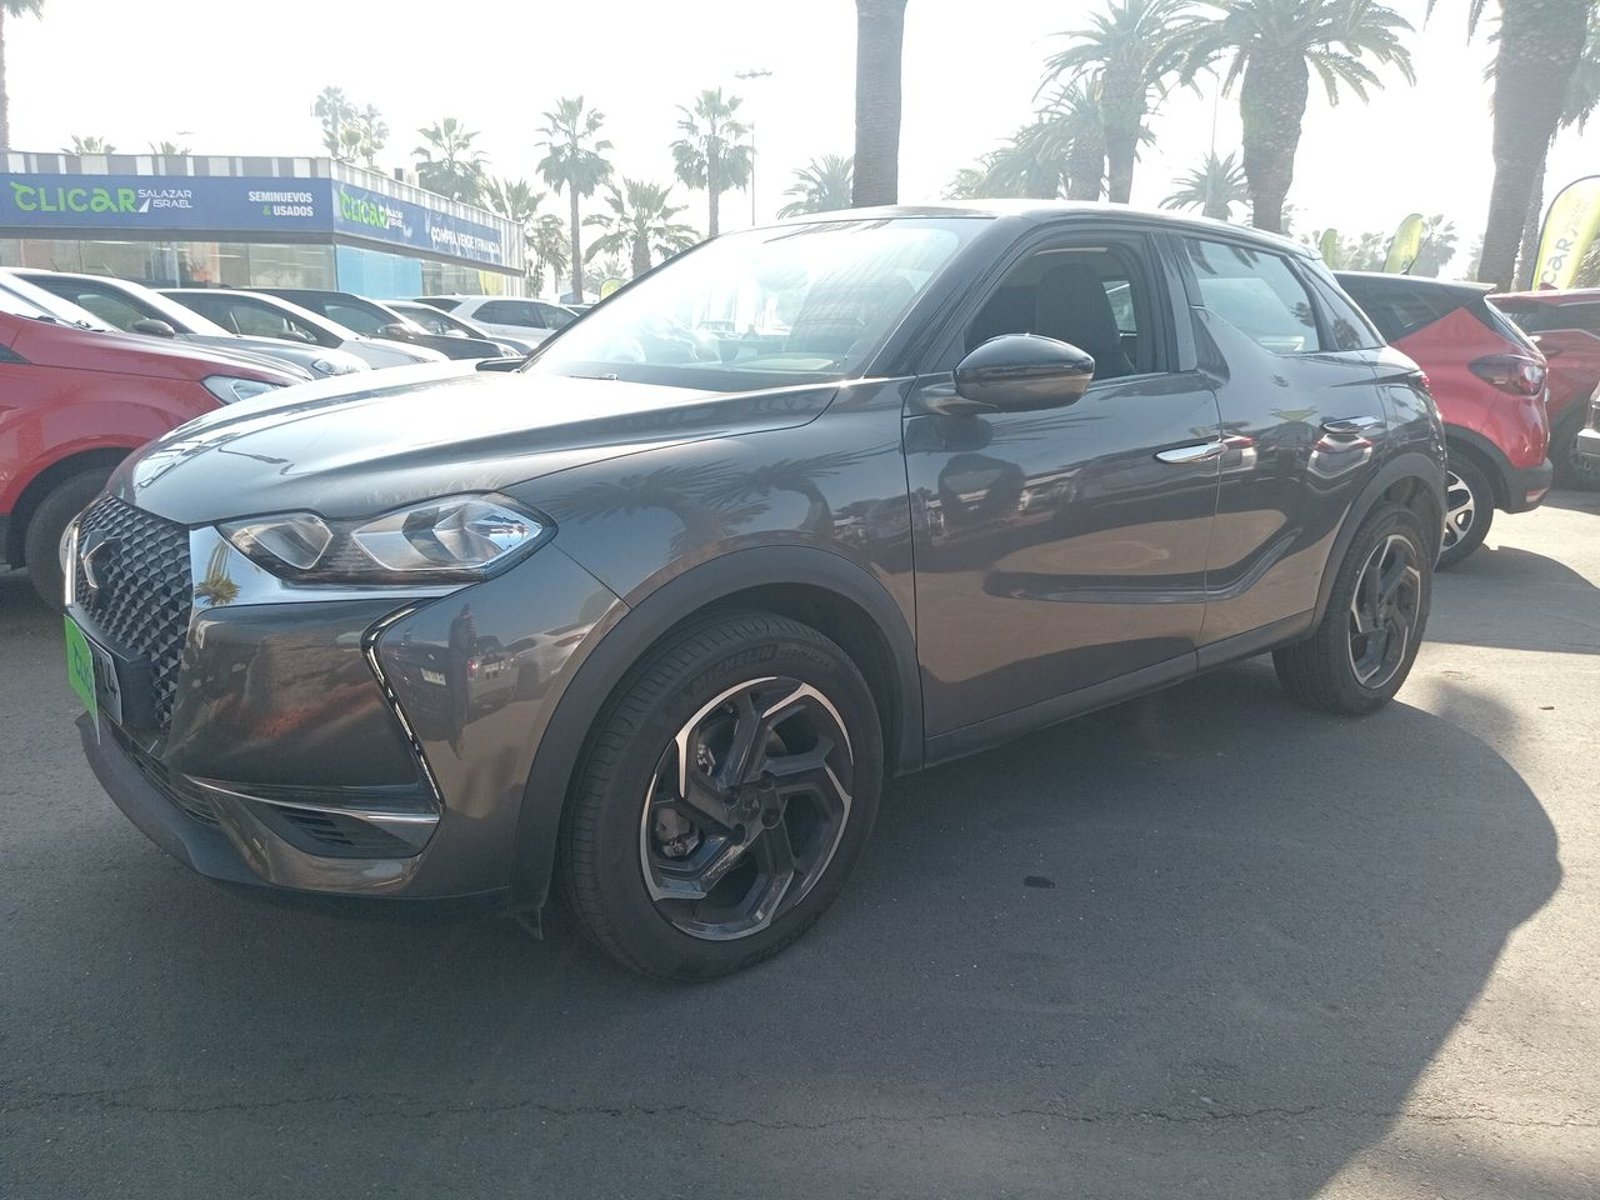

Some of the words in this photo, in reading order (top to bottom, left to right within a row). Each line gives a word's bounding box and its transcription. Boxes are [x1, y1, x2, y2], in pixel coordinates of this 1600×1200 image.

[137, 189, 193, 199] SALAZAR
[248, 190, 313, 203] SEMINUEVOS
[153, 199, 194, 209] ISRAEL
[273, 204, 314, 217] USADOS
